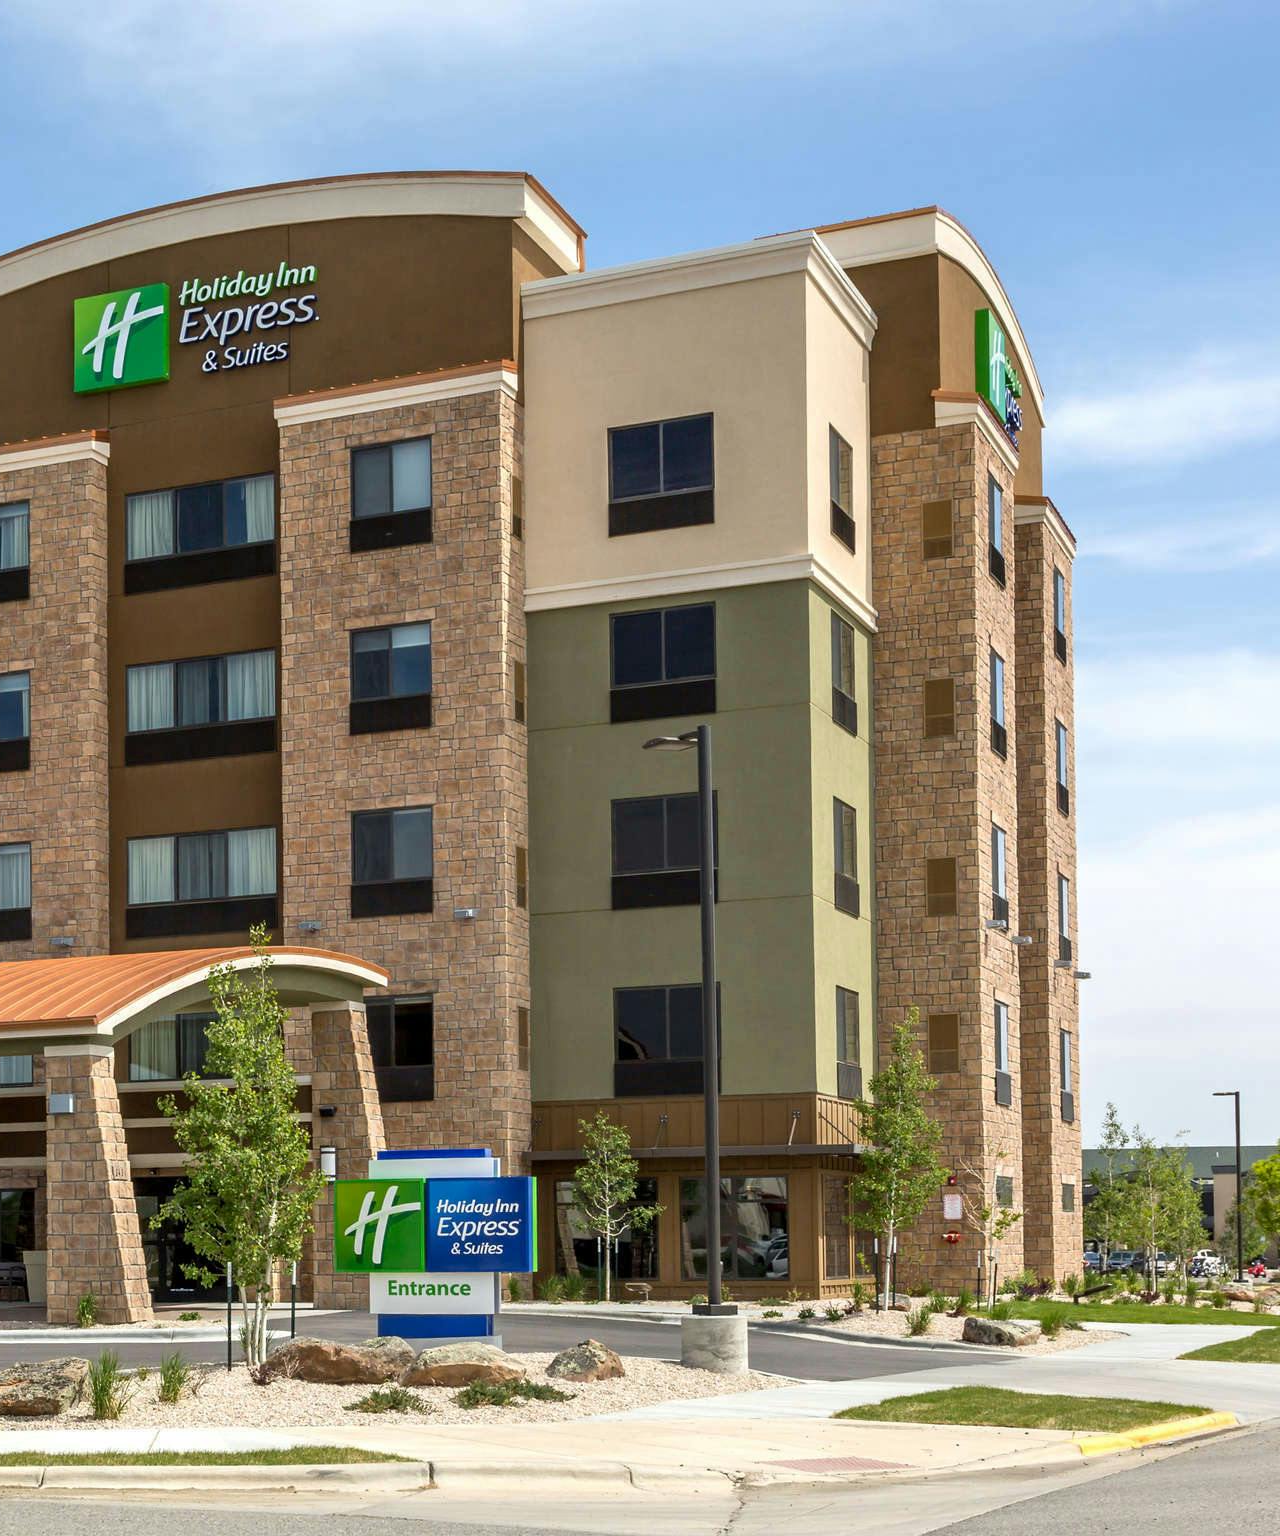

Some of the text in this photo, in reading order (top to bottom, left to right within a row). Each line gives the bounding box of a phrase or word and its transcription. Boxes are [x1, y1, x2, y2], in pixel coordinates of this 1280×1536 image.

[179, 262, 318, 306] Holiday Inn
[201, 342, 288, 372] & Suites
[436, 1198, 520, 1217] Holiday Inn
[436, 1216, 520, 1242] Express
[450, 1242, 504, 1255] & Suites
[387, 1279, 472, 1297] Entrance
